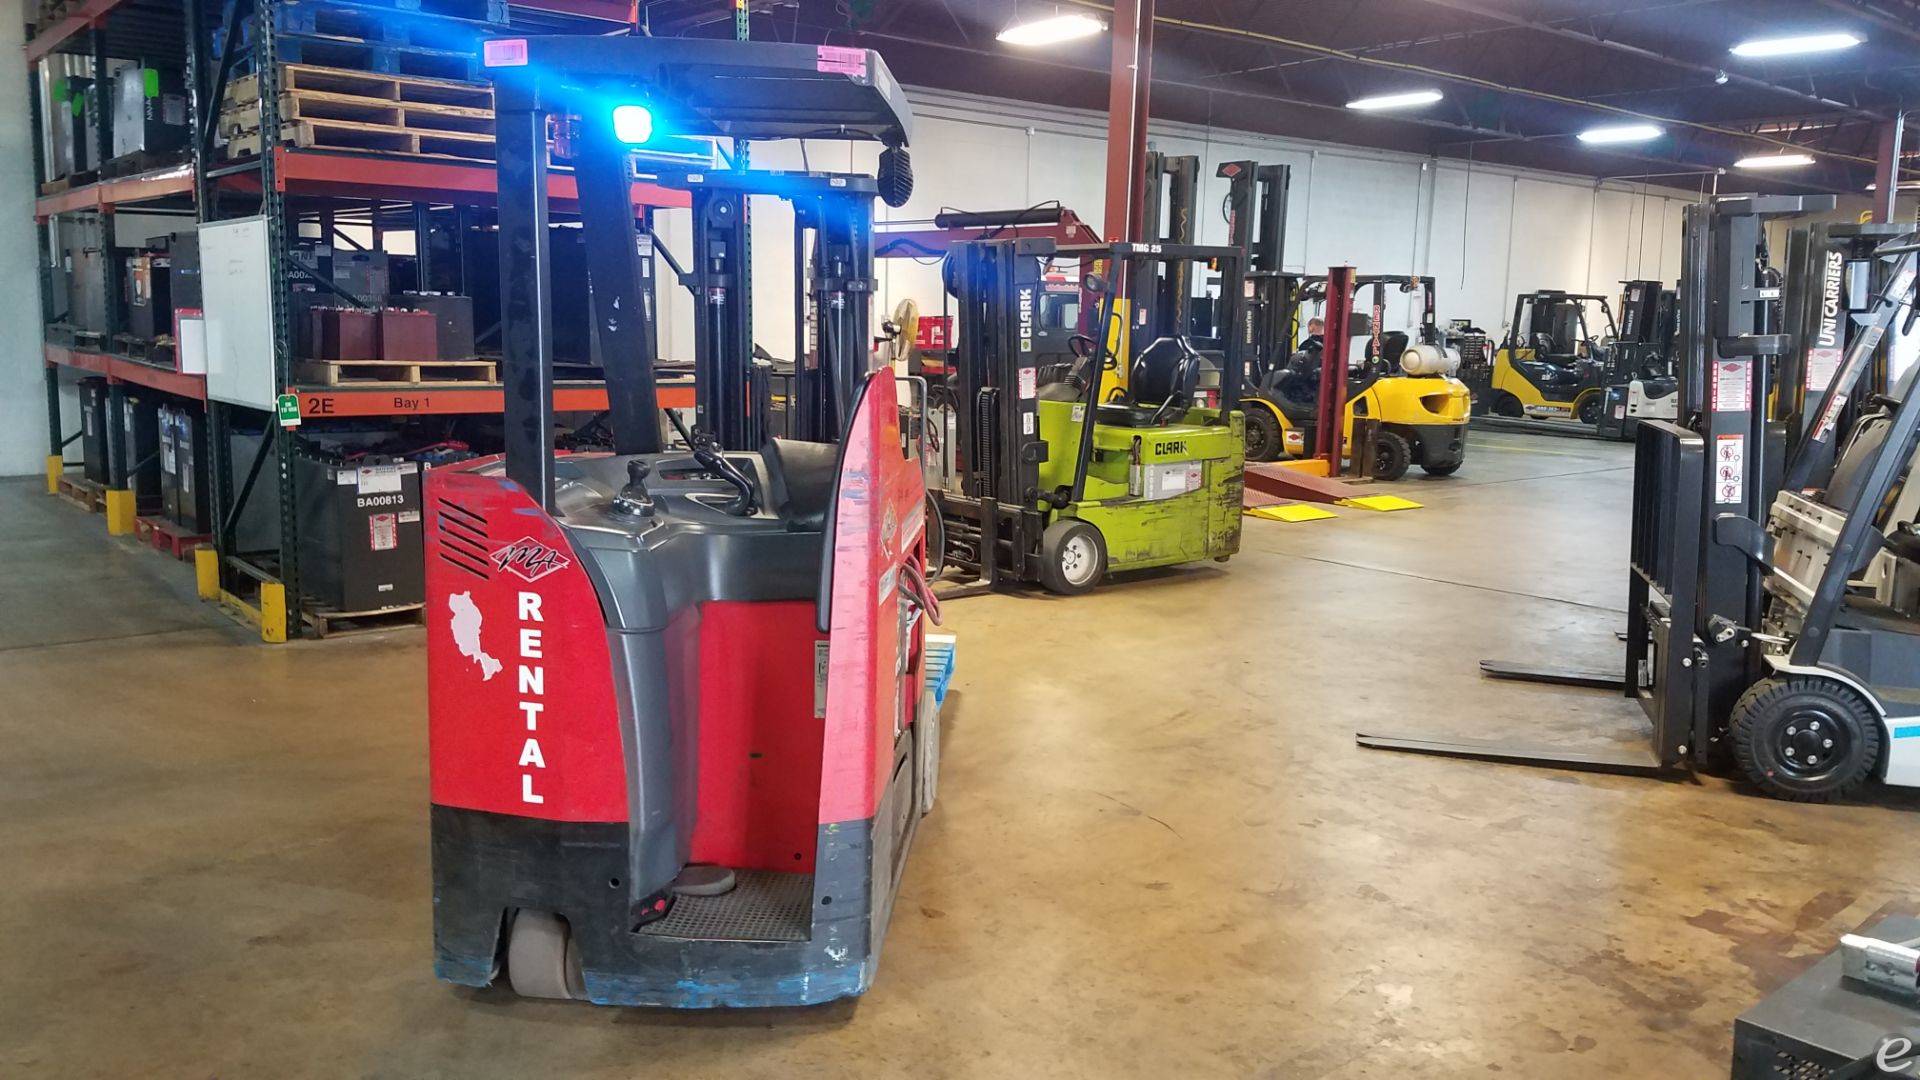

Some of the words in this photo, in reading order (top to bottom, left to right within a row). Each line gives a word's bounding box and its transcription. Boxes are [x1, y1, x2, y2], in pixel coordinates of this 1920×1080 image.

[1131, 243, 1149, 253] TMG
[1020, 288, 1032, 338] CLARK
[1372, 304, 1381, 355] RENTAL
[308, 397, 335, 415] 2E
[394, 397, 419, 410] Bay
[424, 397, 431, 408] 1
[1155, 439, 1188, 456] CLARK
[357, 494, 404, 508] BA00813
[518, 592, 547, 805] RENTAL
